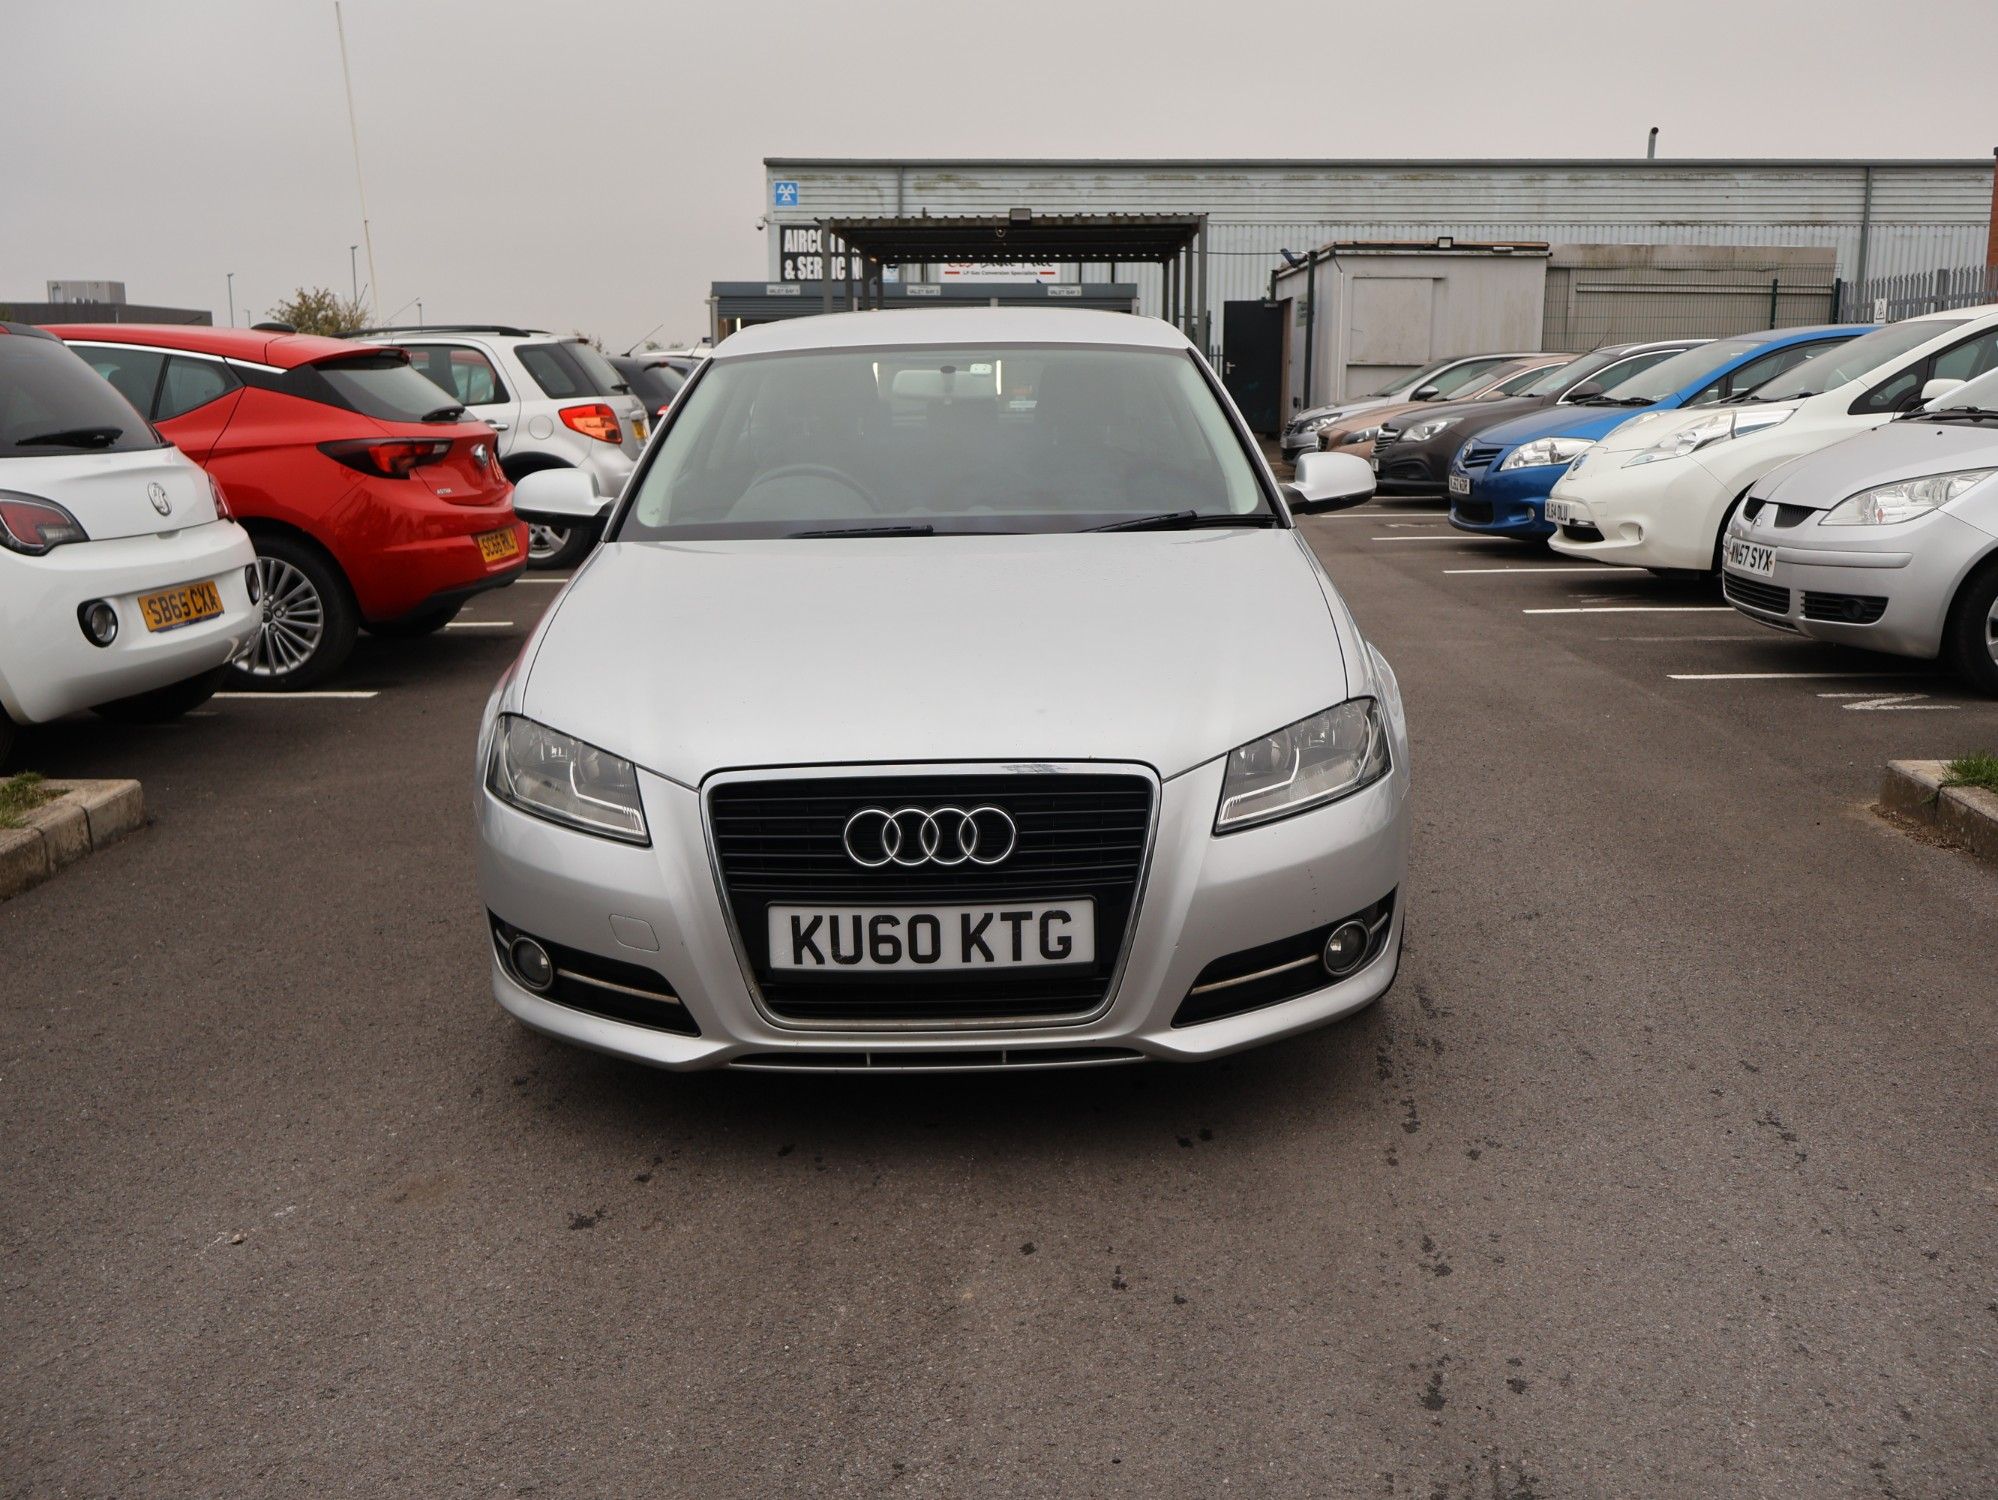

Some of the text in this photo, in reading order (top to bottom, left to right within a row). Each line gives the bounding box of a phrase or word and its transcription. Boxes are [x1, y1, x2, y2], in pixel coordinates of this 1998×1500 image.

[784, 259, 796, 280] &
[1750, 547, 1772, 571] SYX
[148, 592, 192, 625] SB65
[791, 910, 1073, 965] KU60 KTG
